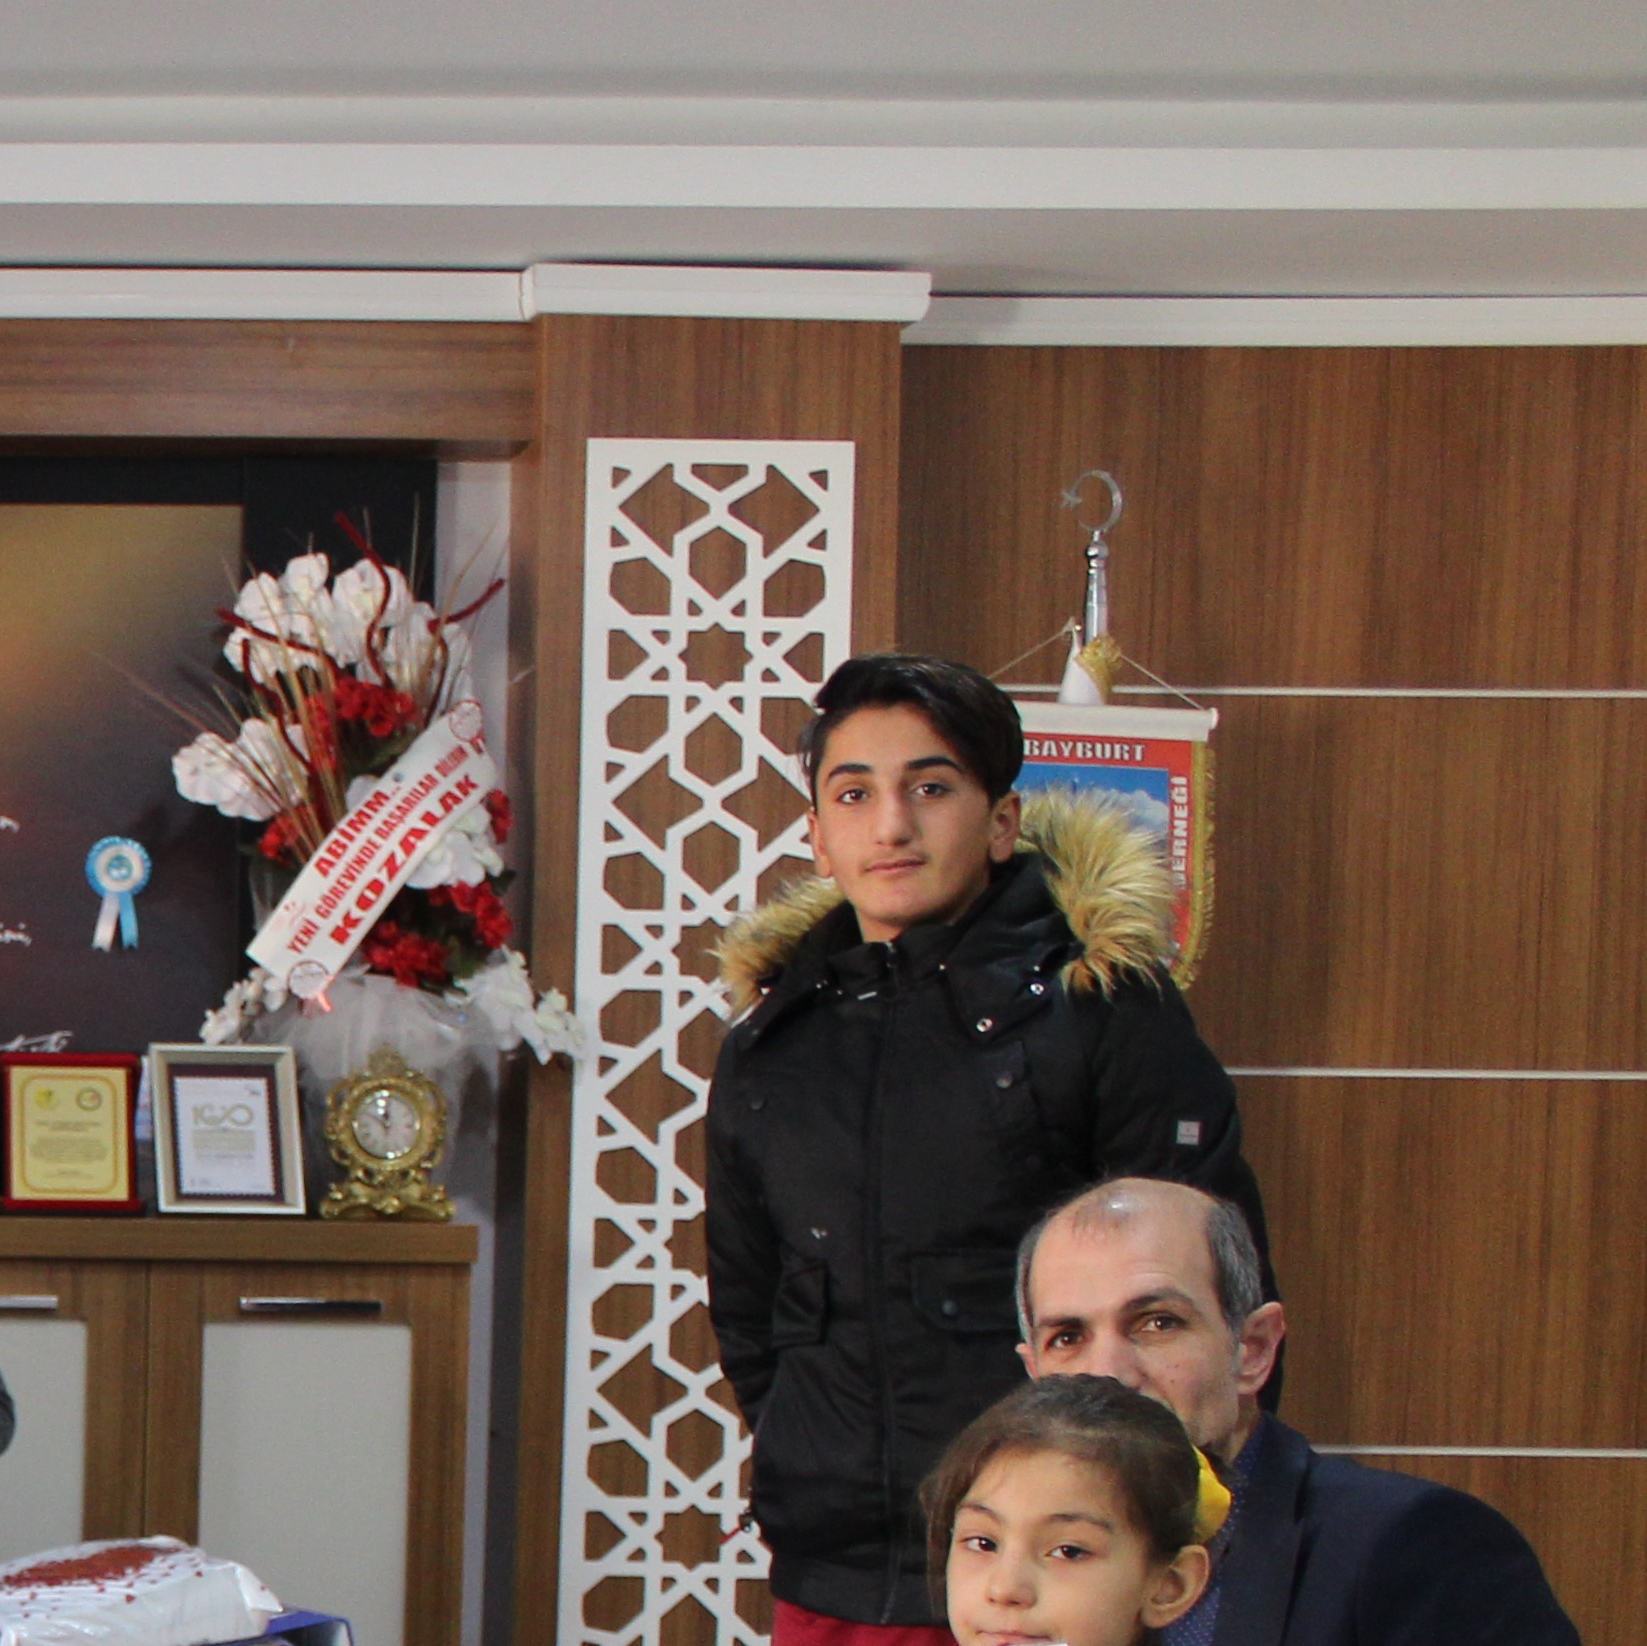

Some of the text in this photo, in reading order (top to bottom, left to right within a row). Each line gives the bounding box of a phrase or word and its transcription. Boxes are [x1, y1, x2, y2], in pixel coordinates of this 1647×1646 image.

[1023, 738, 1146, 762] BAYBURT
[287, 917, 321, 954] YENİ
[315, 837, 380, 920] GÖREVİNDE
[374, 773, 440, 842] BAŞARILAR
[329, 773, 479, 945] KOZALAK
